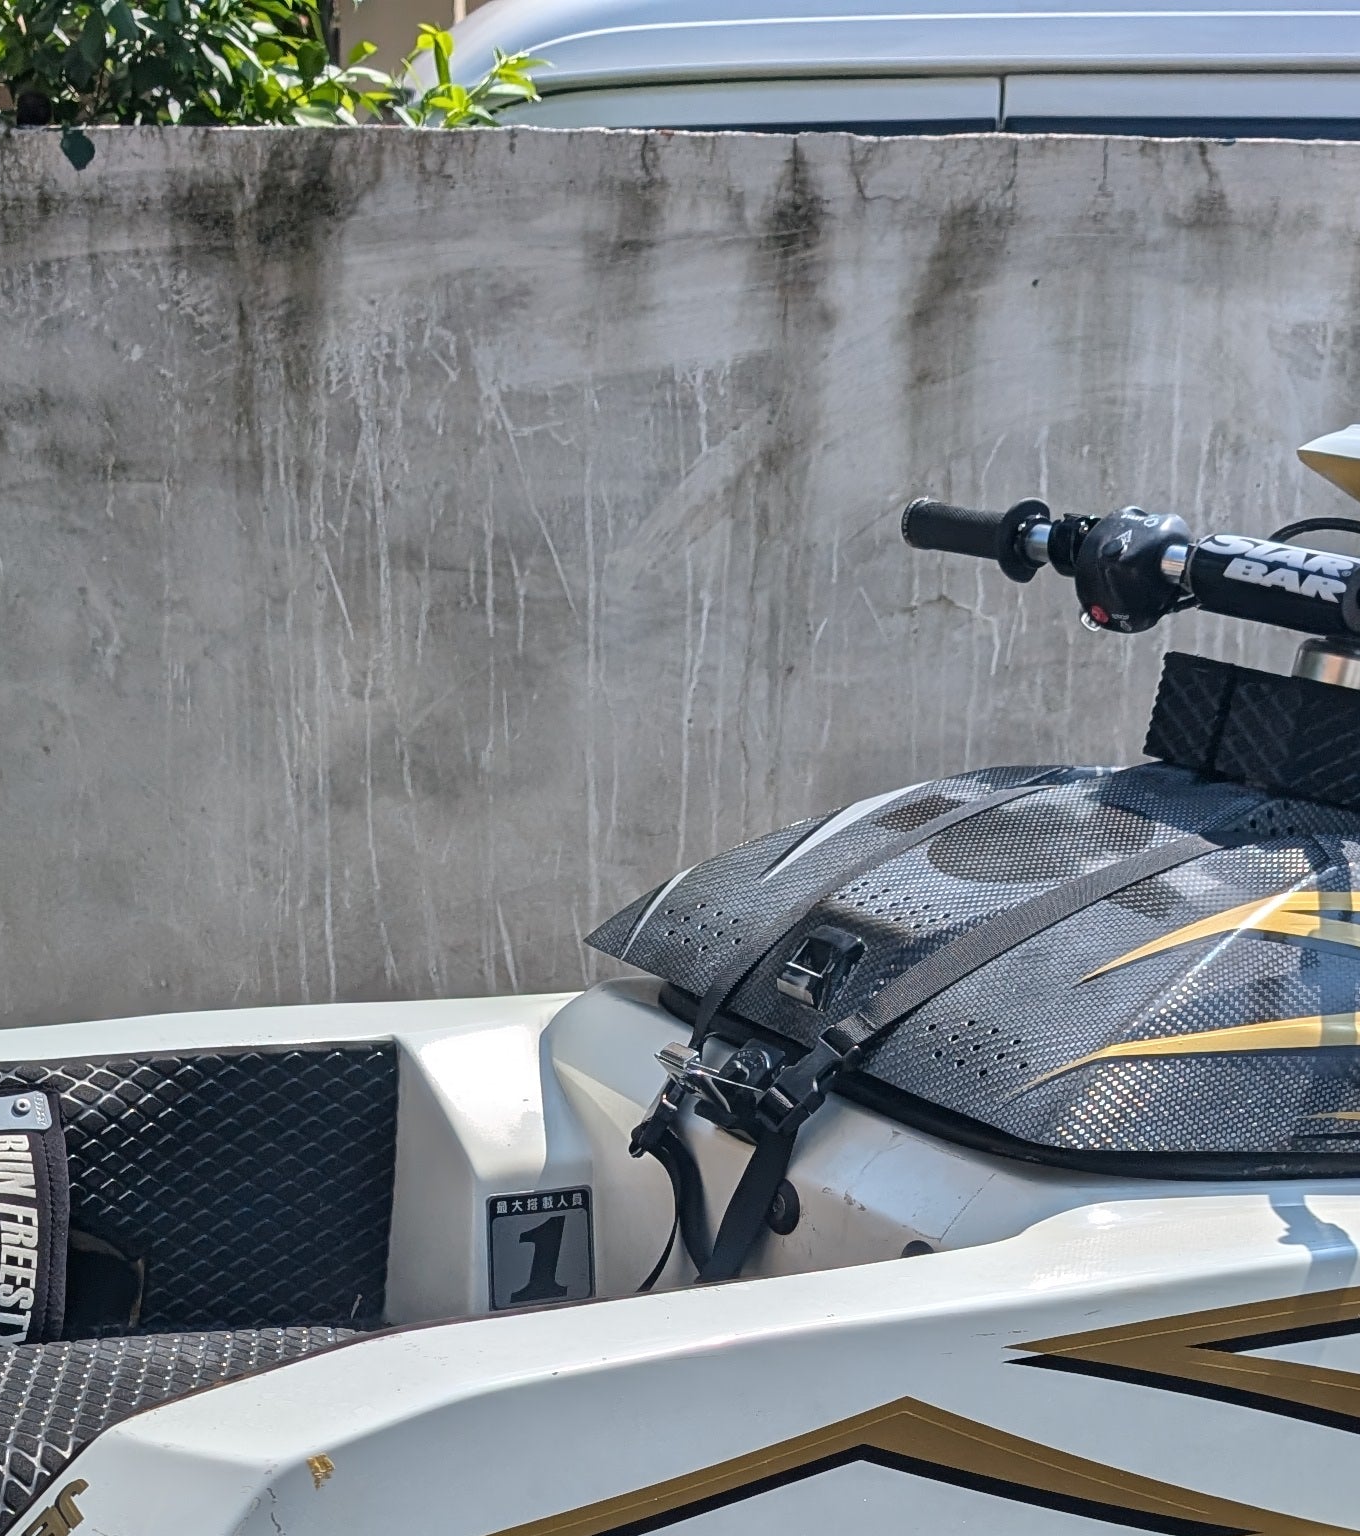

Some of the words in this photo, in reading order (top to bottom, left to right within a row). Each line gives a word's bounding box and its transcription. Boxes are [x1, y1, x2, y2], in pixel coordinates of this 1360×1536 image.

[1198, 534, 1354, 578] STAR
[1223, 557, 1348, 604] BAR
[496, 1192, 583, 1214] 最大搭載人員
[509, 1214, 568, 1304] 1
